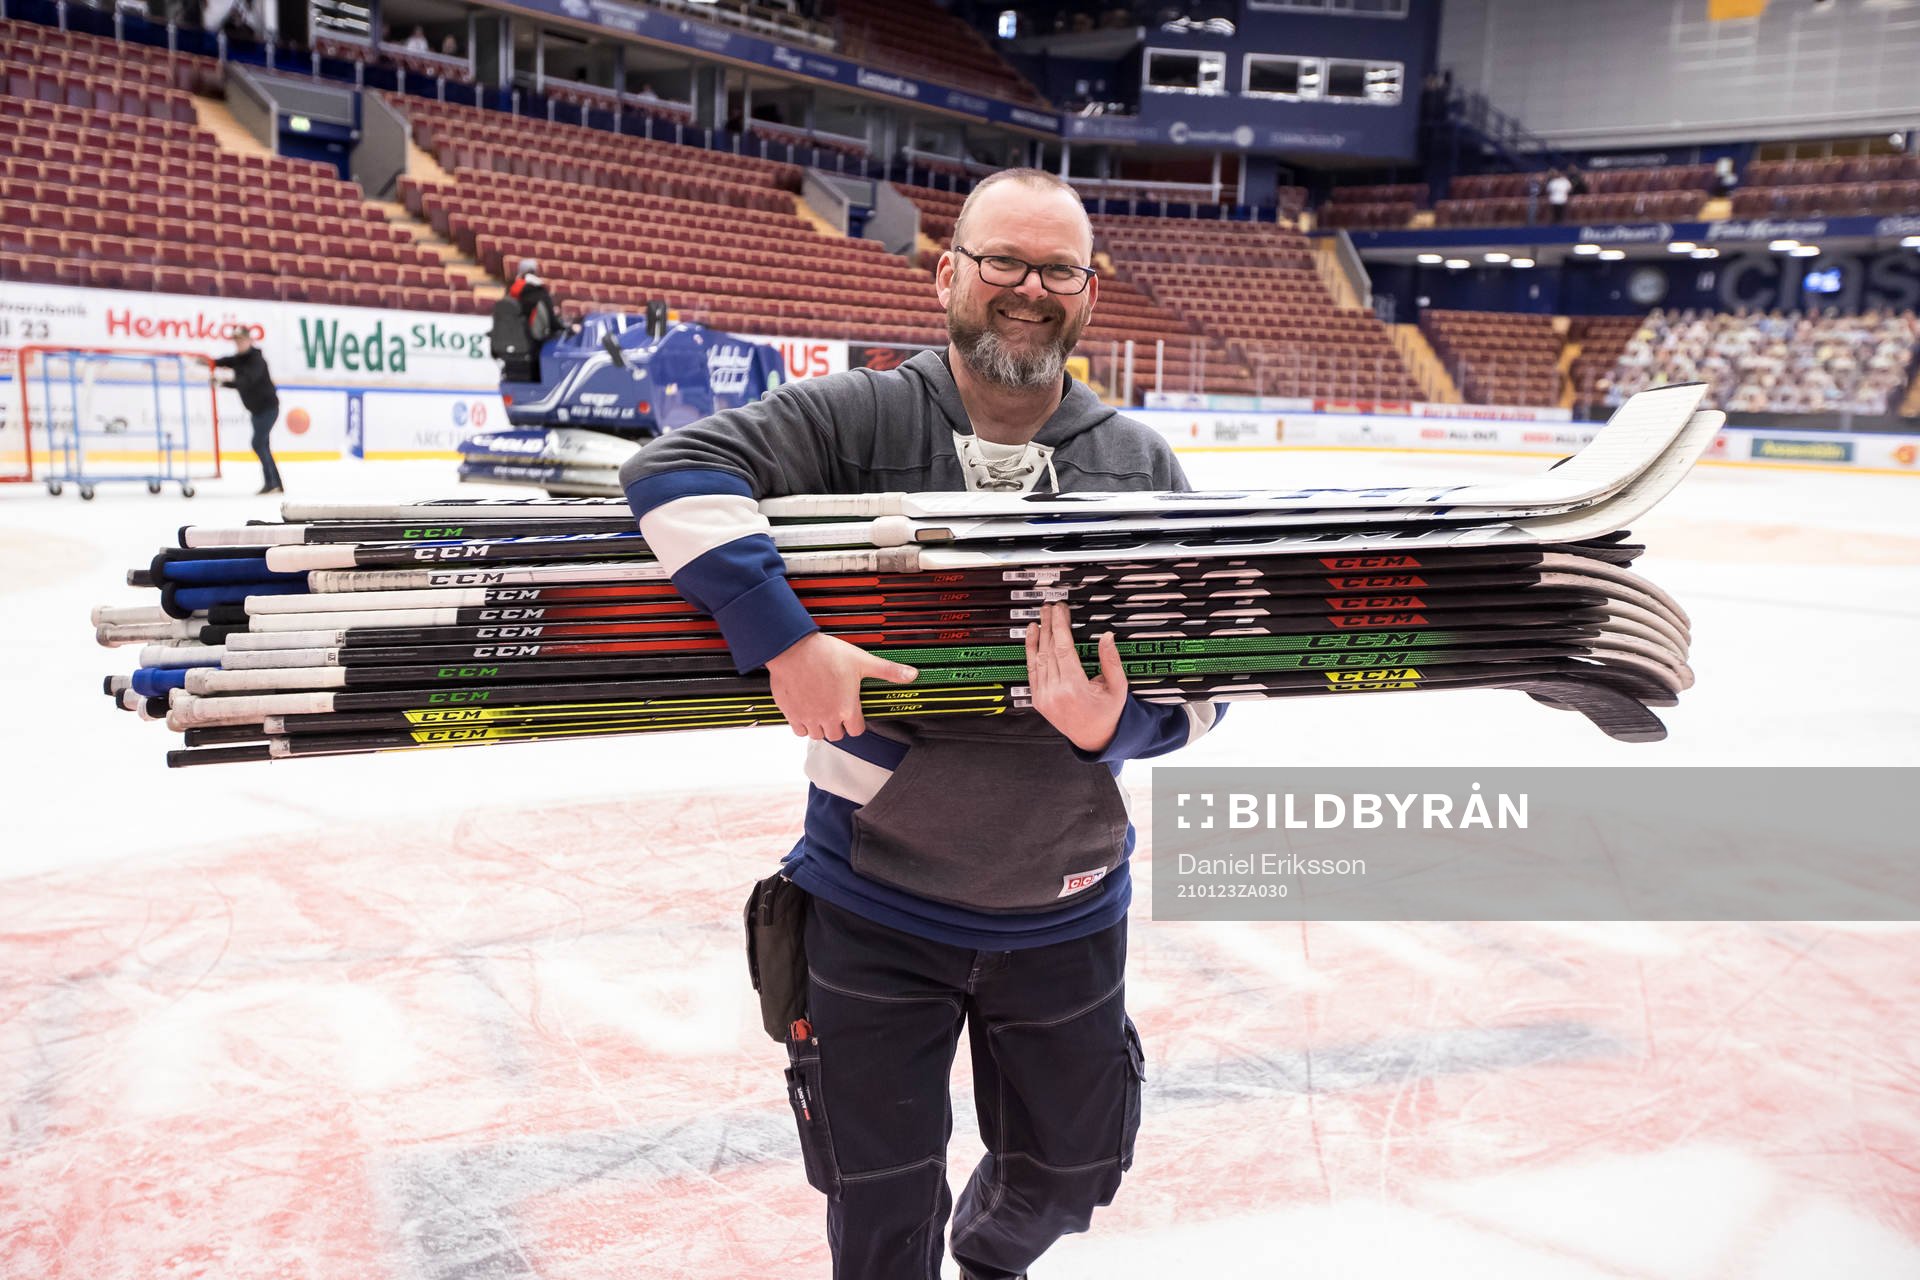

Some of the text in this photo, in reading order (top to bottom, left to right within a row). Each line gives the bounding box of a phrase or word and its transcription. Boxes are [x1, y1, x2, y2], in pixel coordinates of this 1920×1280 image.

[300, 317, 485, 373] Weda Skog
[402, 527, 464, 539] CCM
[414, 545, 490, 560] CCM
[1334, 556, 1407, 568] CCM
[430, 572, 505, 586] CCM
[1342, 576, 1413, 588] CCM
[1340, 596, 1412, 608] CCM
[478, 608, 545, 620] CCM
[1342, 613, 1414, 626] CCM
[476, 626, 545, 638] CCM
[1307, 632, 1420, 649] CCM
[473, 645, 541, 658] CCM
[1297, 652, 1410, 667] CCM
[437, 667, 499, 678] CCM
[1337, 669, 1407, 681] CCM
[429, 691, 490, 703] CCM
[421, 710, 482, 722] CCM
[427, 729, 488, 741] CCM
